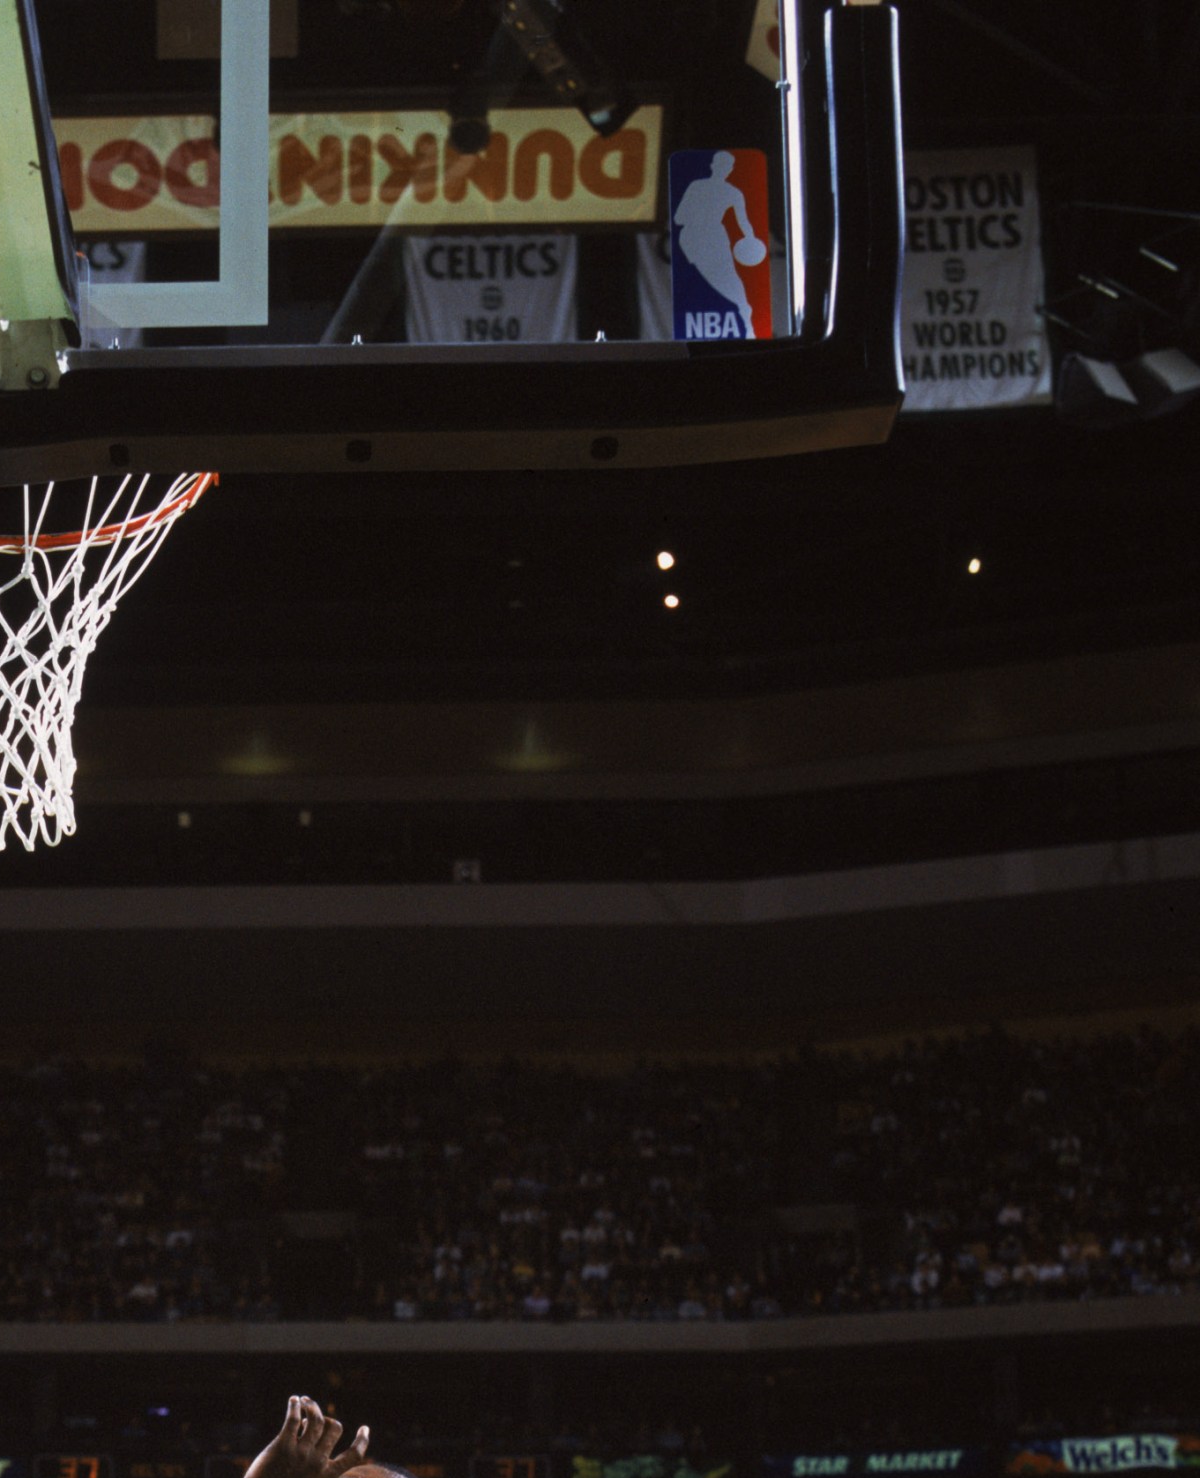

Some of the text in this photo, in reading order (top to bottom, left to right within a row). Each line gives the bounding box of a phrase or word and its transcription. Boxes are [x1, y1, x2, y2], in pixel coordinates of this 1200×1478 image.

[268, 130, 645, 206] DUNKIN
[905, 173, 1023, 212] OSTON
[906, 213, 1022, 253] ELTICS
[424, 242, 560, 281] CELTICS
[924, 288, 980, 316] 1957
[463, 317, 521, 342] 1960
[685, 311, 740, 339] NBA
[913, 320, 1006, 348] WORLD
[904, 349, 1040, 381] HAMPIONS
[791, 1447, 964, 1478] STAR MARKET
[1066, 1436, 1171, 1469] Welch's
